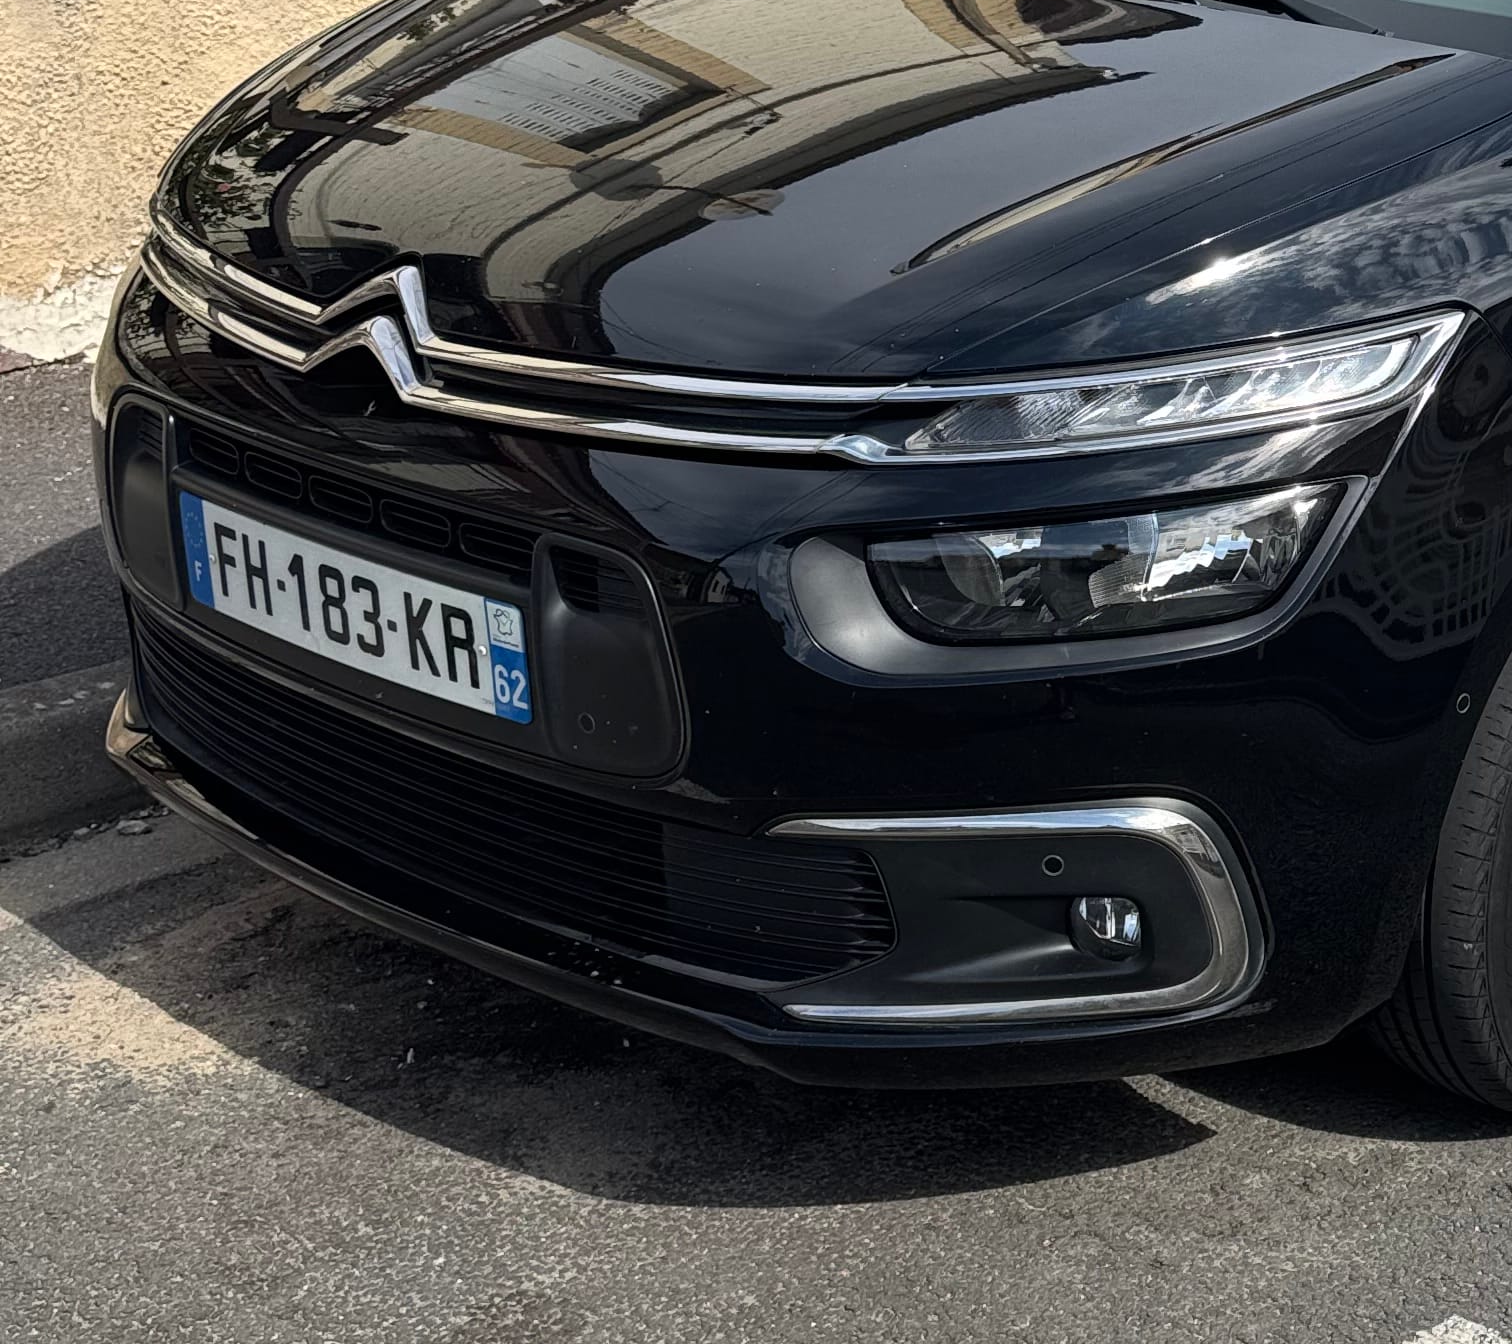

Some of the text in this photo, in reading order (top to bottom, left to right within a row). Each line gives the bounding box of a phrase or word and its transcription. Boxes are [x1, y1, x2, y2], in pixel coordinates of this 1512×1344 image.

[194, 560, 202, 582] F
[214, 522, 481, 689] FH-183-KR
[494, 664, 529, 710] 62
